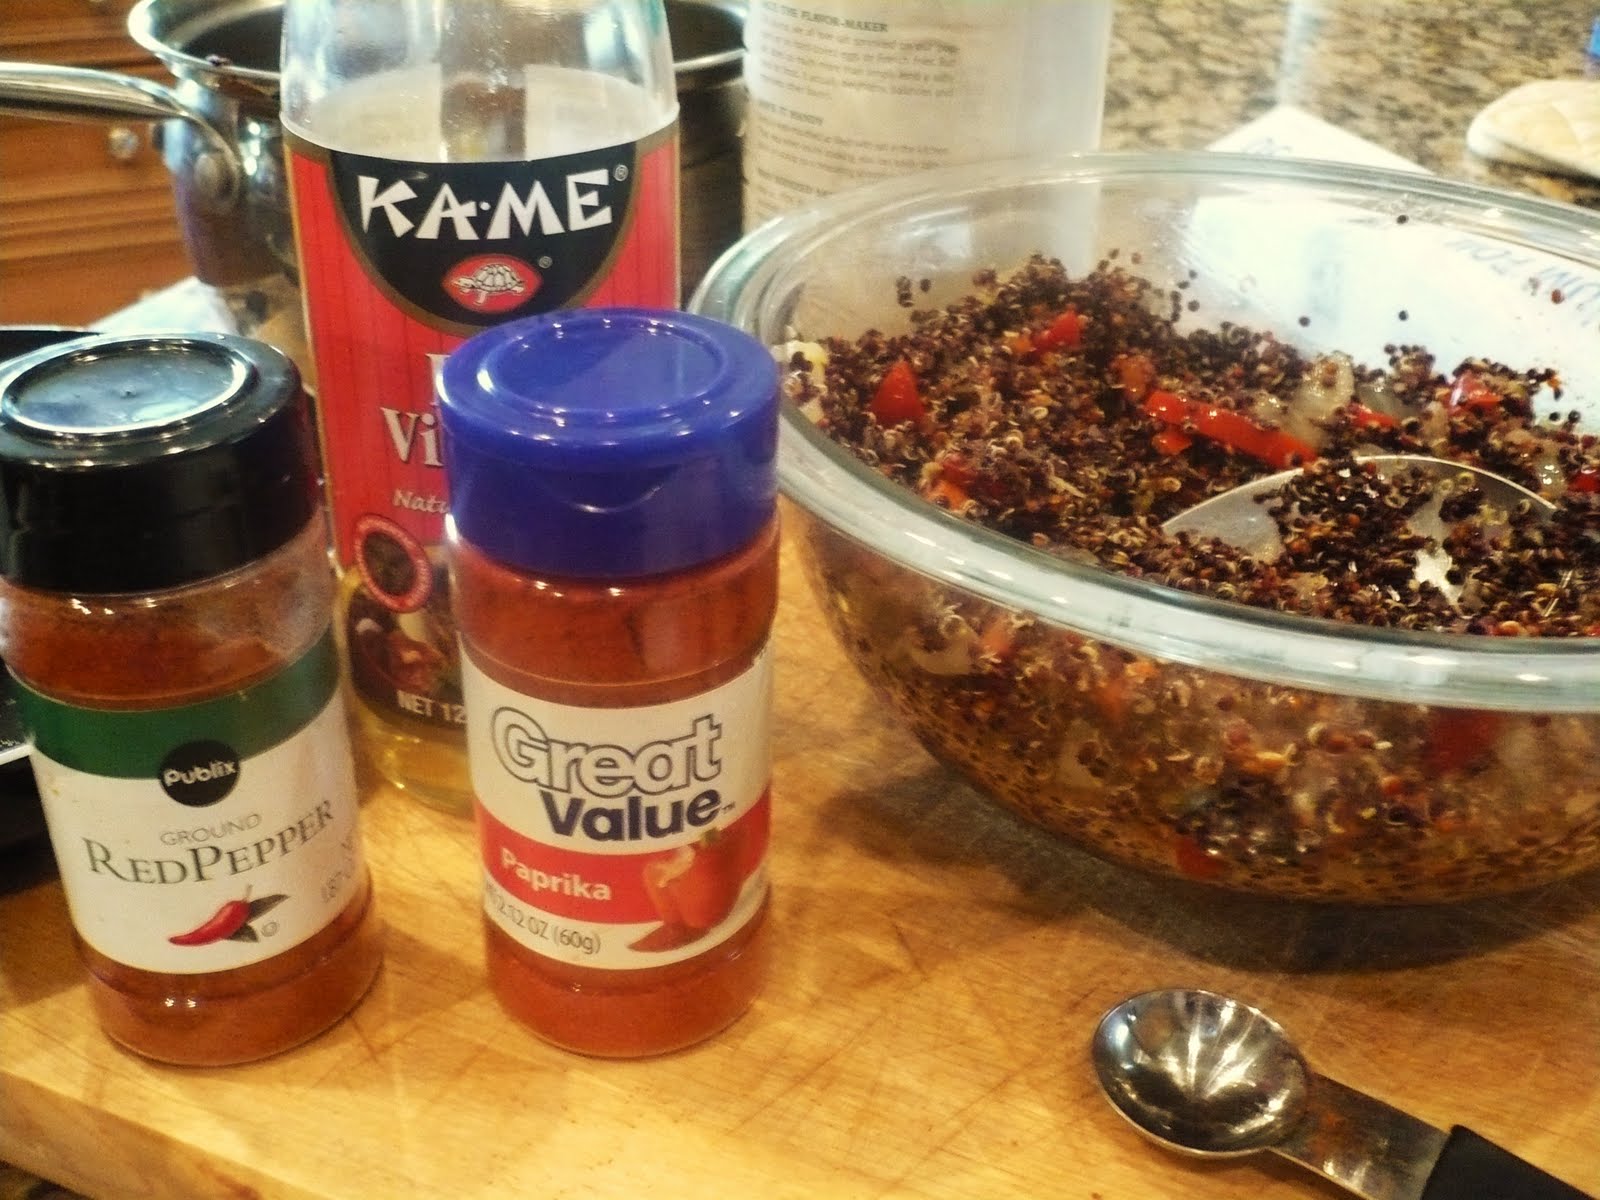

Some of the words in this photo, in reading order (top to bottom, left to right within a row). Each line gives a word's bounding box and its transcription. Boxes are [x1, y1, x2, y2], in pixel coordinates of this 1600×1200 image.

[396, 690, 434, 717] NET
[163, 760, 236, 786] Publix
[491, 706, 722, 799] Great
[160, 814, 262, 846] GROUND
[540, 789, 721, 841] Value
[82, 837, 188, 884] RED
[187, 800, 334, 883] PEPPER
[502, 848, 612, 901] Paprika
[527, 915, 549, 940] OZ
[551, 925, 601, 956] (60g)
